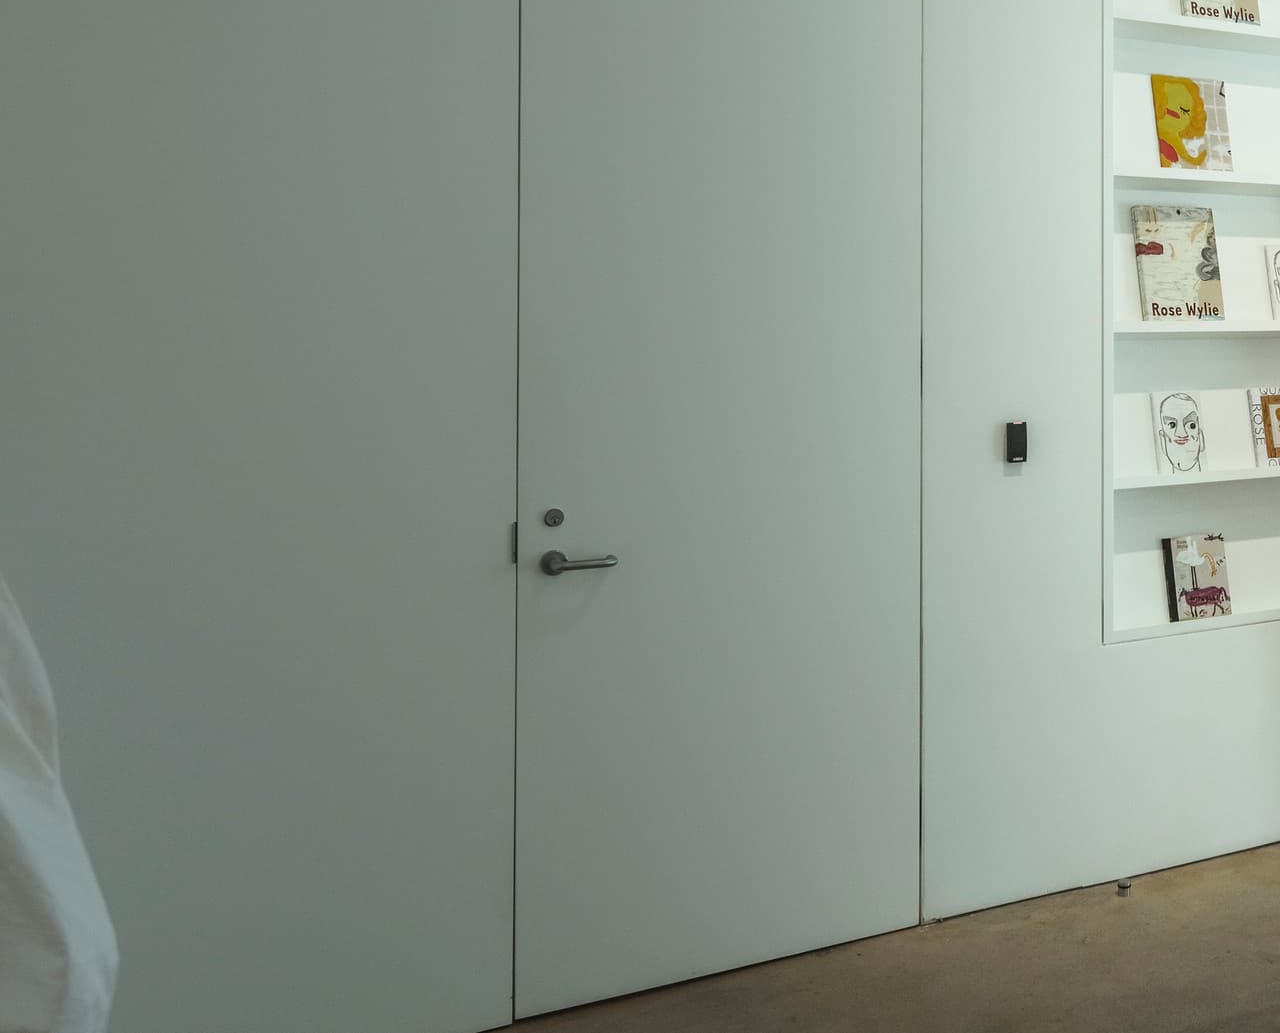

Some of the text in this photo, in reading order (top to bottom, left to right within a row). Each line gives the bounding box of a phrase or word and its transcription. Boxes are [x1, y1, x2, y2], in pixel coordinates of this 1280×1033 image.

[1190, 1, 1255, 24] Rose Wylie
[1151, 302, 1220, 319] Rose Wylie
[1251, 403, 1265, 446] ROSE
